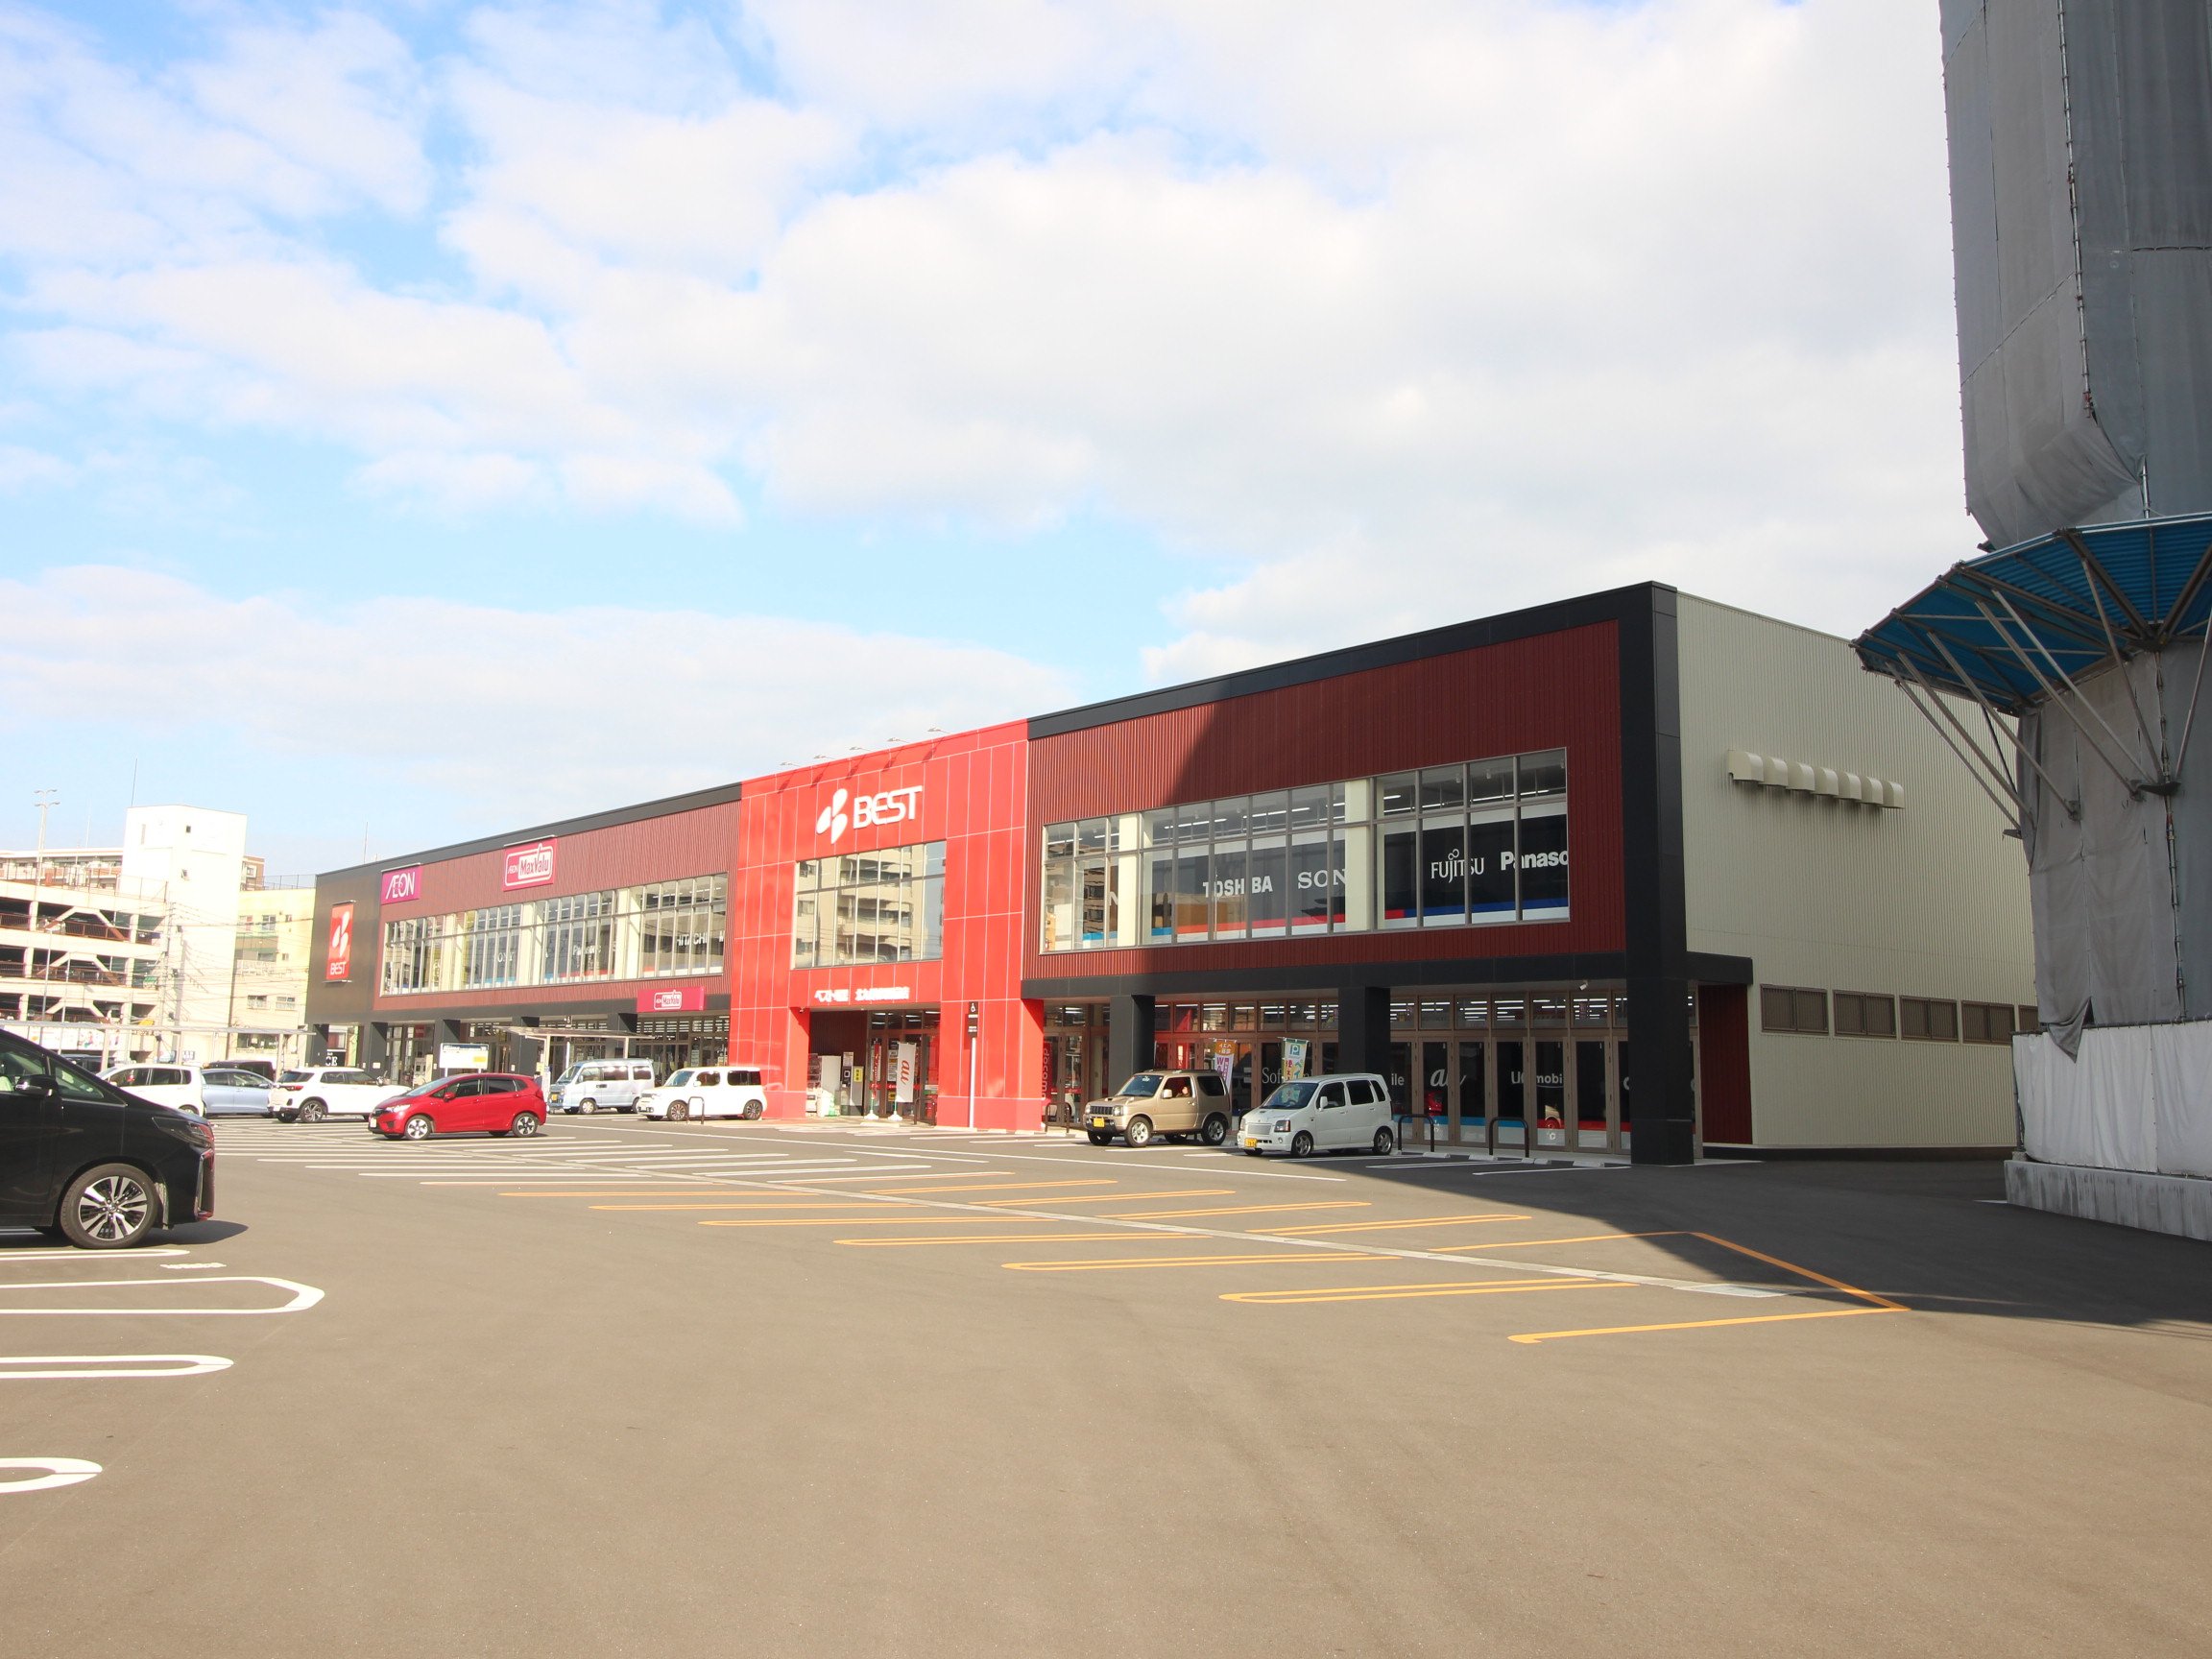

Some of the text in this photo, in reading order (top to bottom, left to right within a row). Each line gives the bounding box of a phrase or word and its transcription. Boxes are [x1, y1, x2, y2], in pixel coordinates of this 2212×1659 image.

[854, 785, 923, 830] BEST
[1202, 876, 1273, 899] TOSHBA
[1297, 869, 1345, 889] SON
[329, 960, 348, 975] BEST
[901, 1060, 910, 1085] au
[1536, 1072, 1563, 1084] mobi
